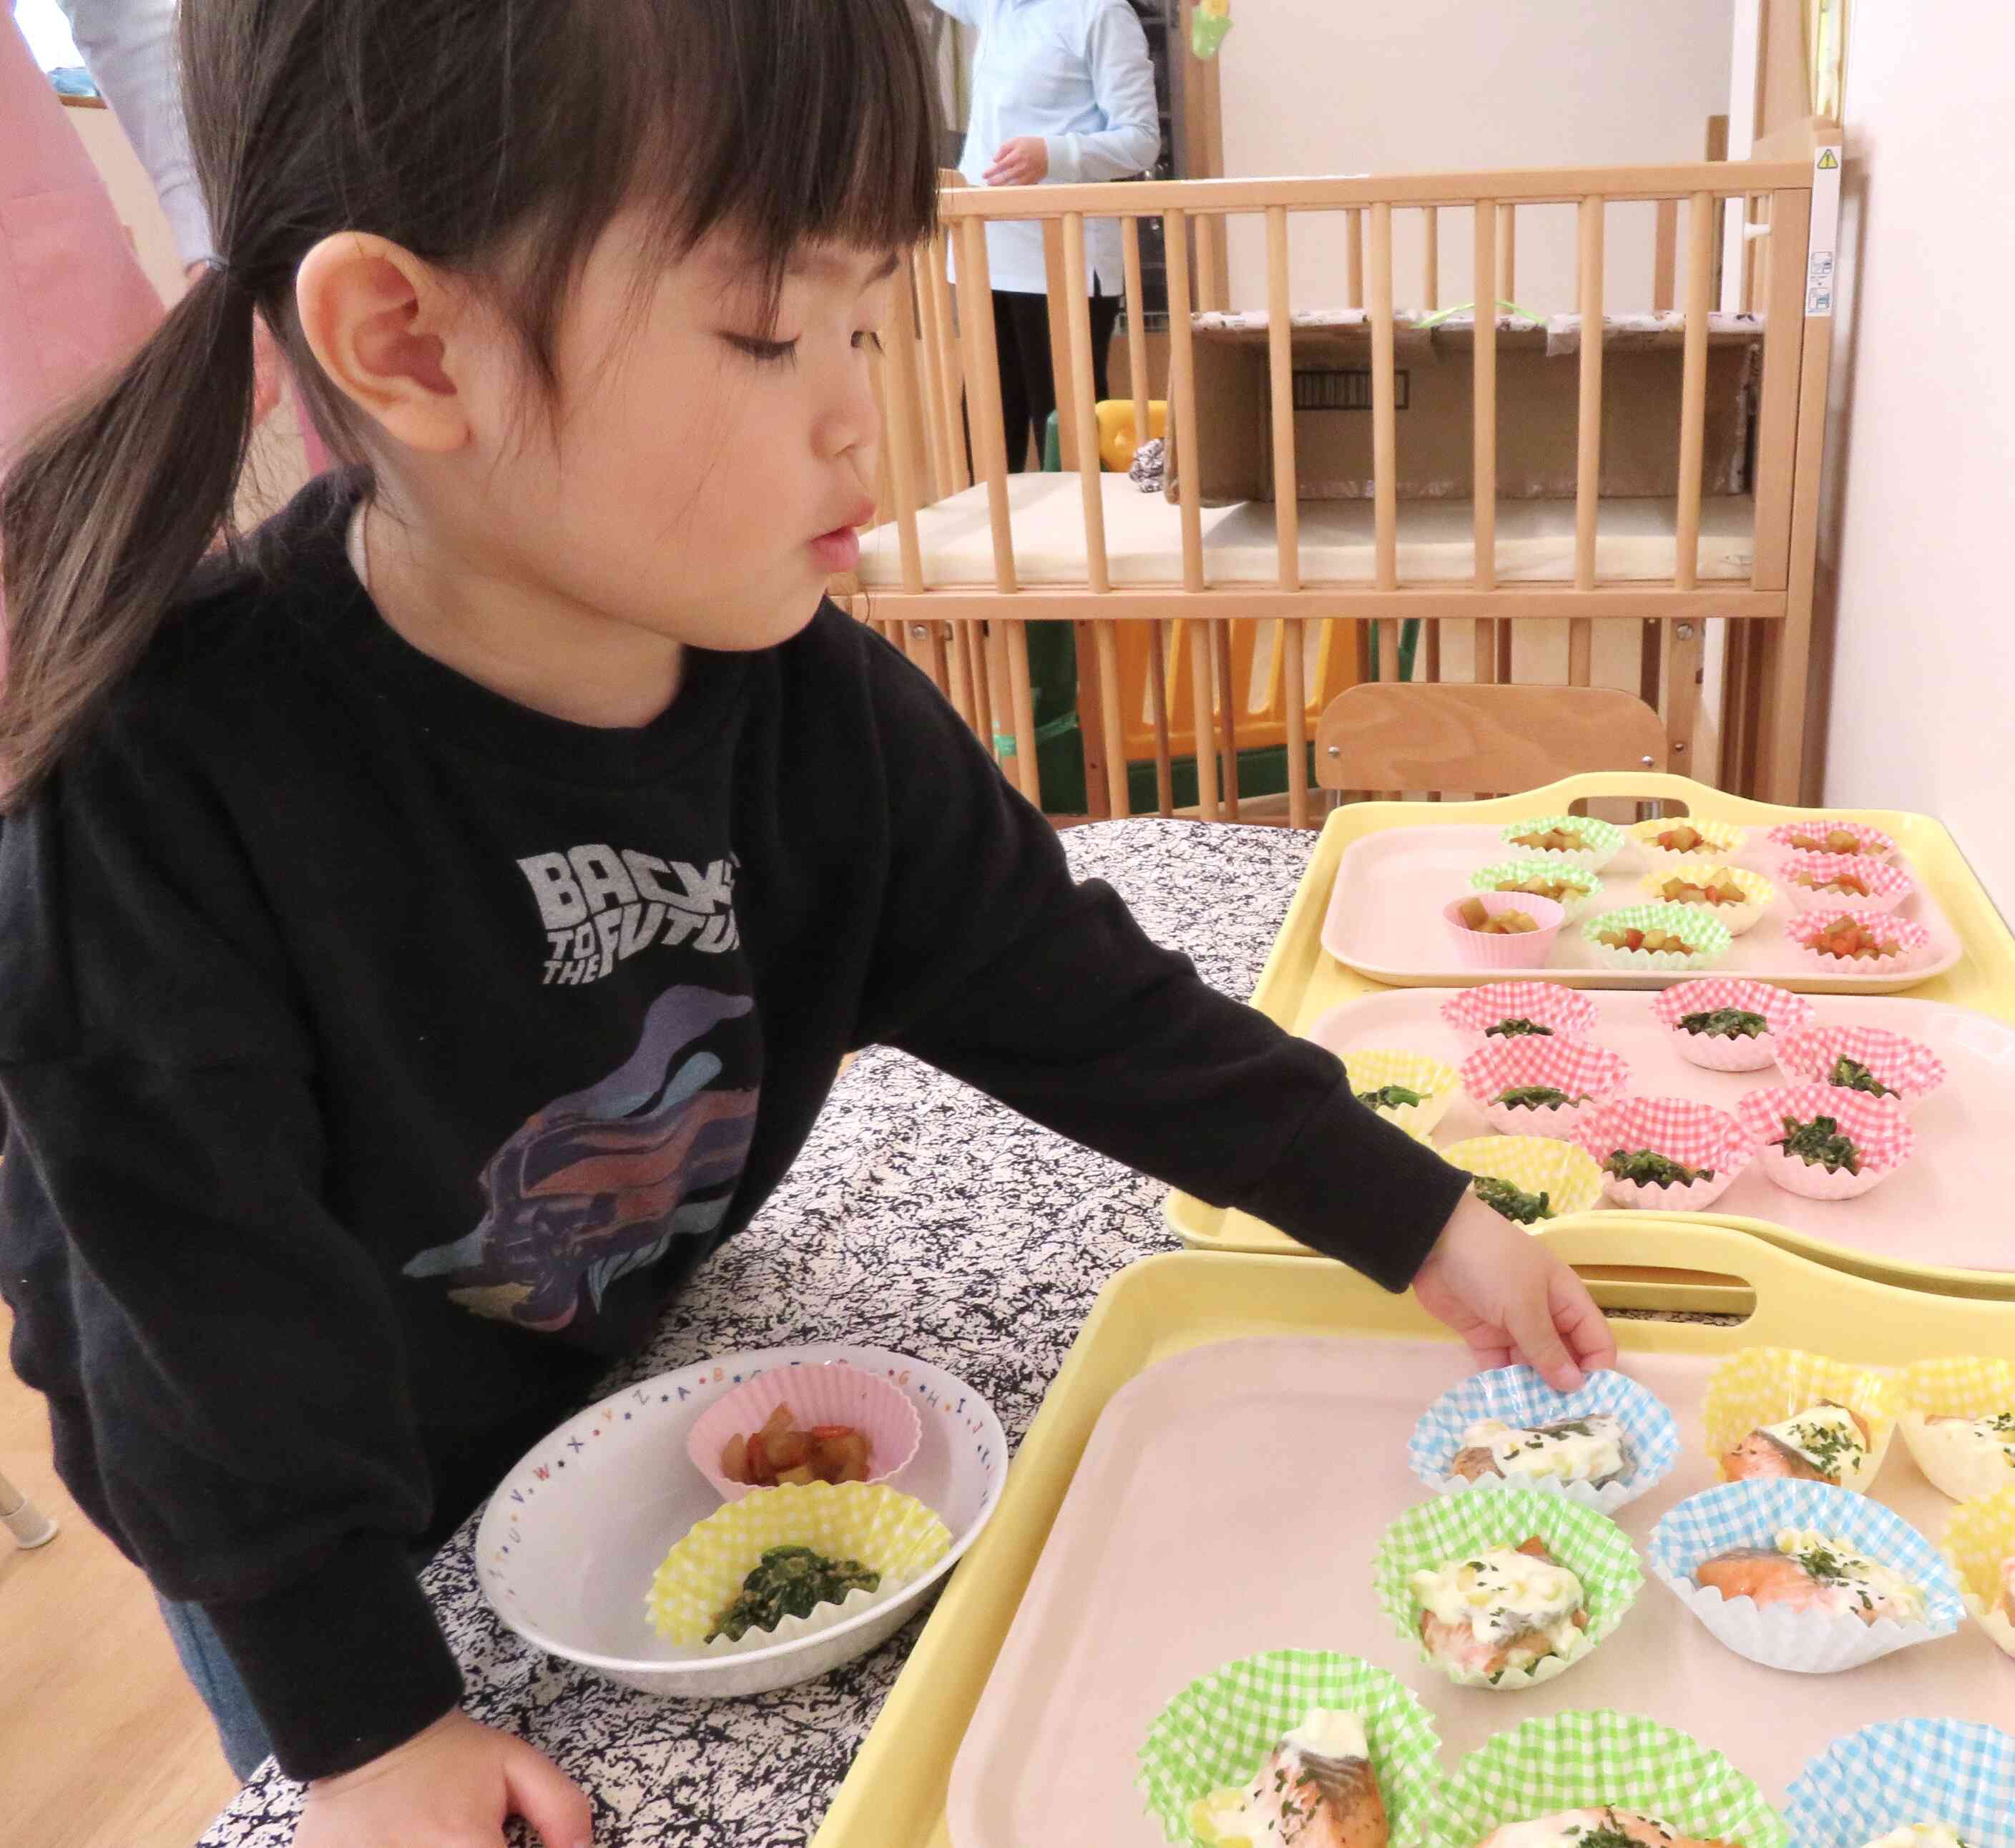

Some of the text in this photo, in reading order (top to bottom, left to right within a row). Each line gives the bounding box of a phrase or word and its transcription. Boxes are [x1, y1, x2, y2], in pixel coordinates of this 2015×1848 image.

[546, 921, 596, 960] TO
[593, 902, 740, 979] FUTU
[541, 953, 600, 984] THE
